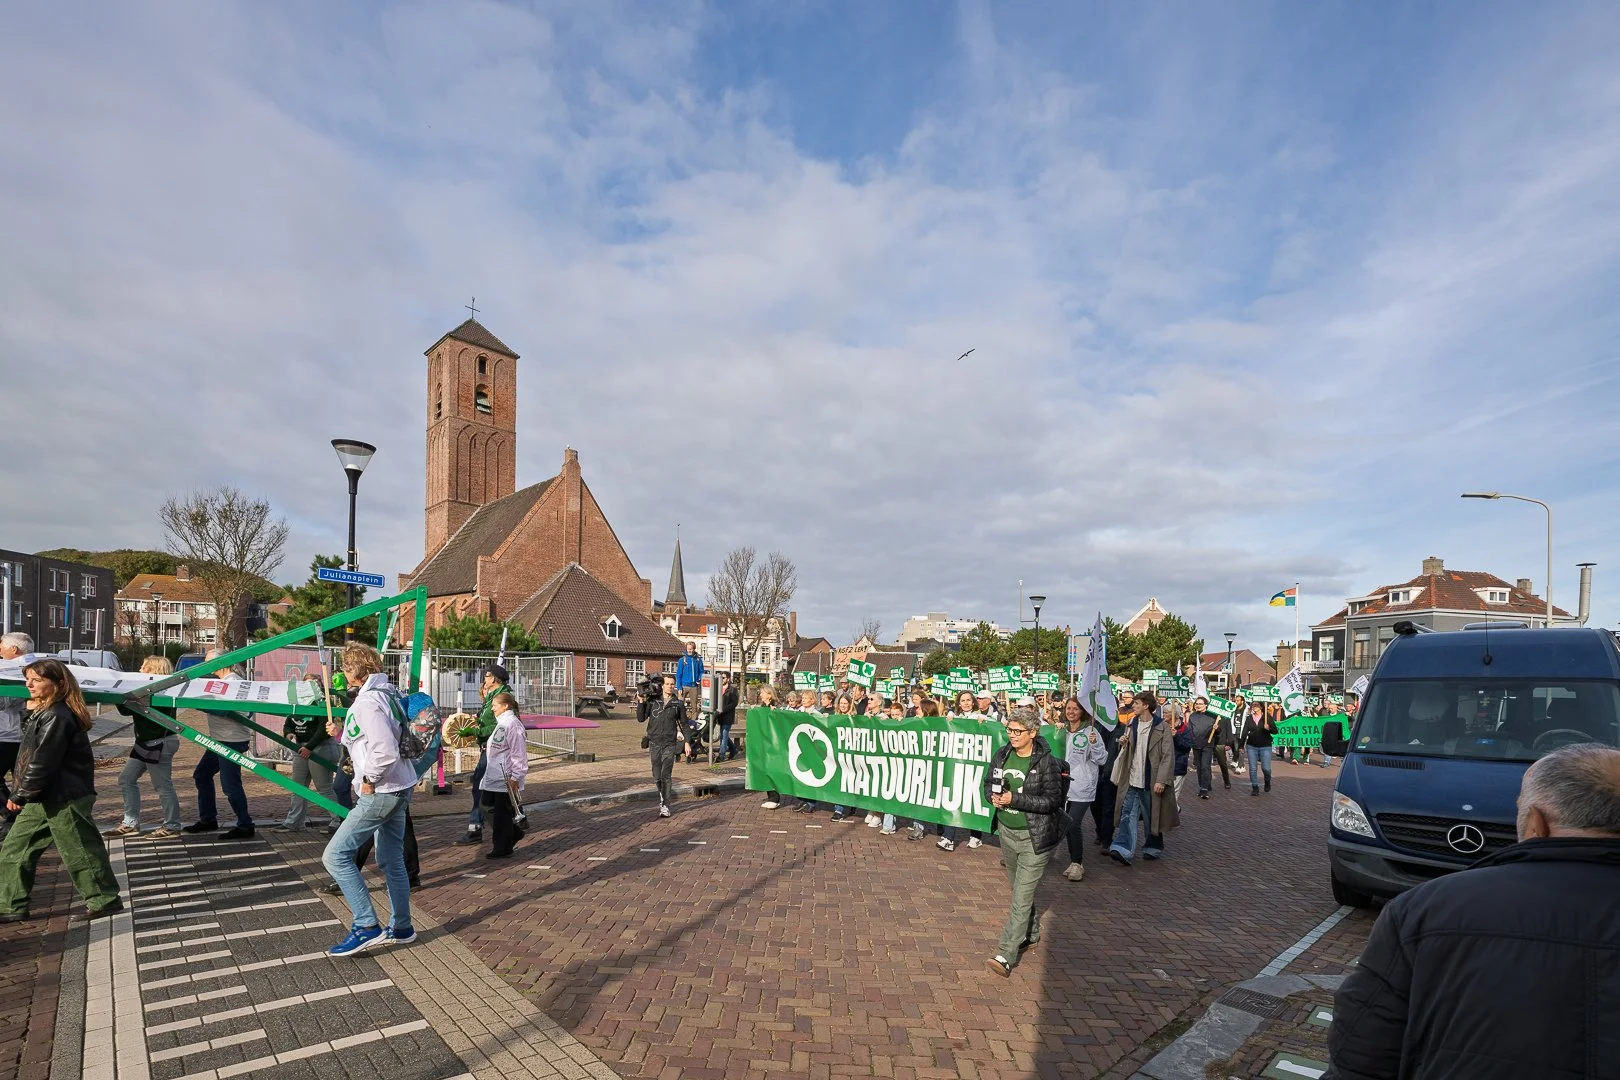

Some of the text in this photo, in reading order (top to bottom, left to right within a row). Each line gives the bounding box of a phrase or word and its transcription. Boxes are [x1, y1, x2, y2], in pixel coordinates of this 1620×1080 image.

[324, 571, 379, 583] Julianaplein
[1278, 725, 1323, 735] OEN STA
[836, 727, 992, 763] PARTIJ VOOR DE DIEREN
[1277, 738, 1320, 746] EEN ILLUS
[229, 752, 240, 761] BY
[237, 756, 257, 770] MADE
[837, 752, 990, 817] NATUURLIJK.
